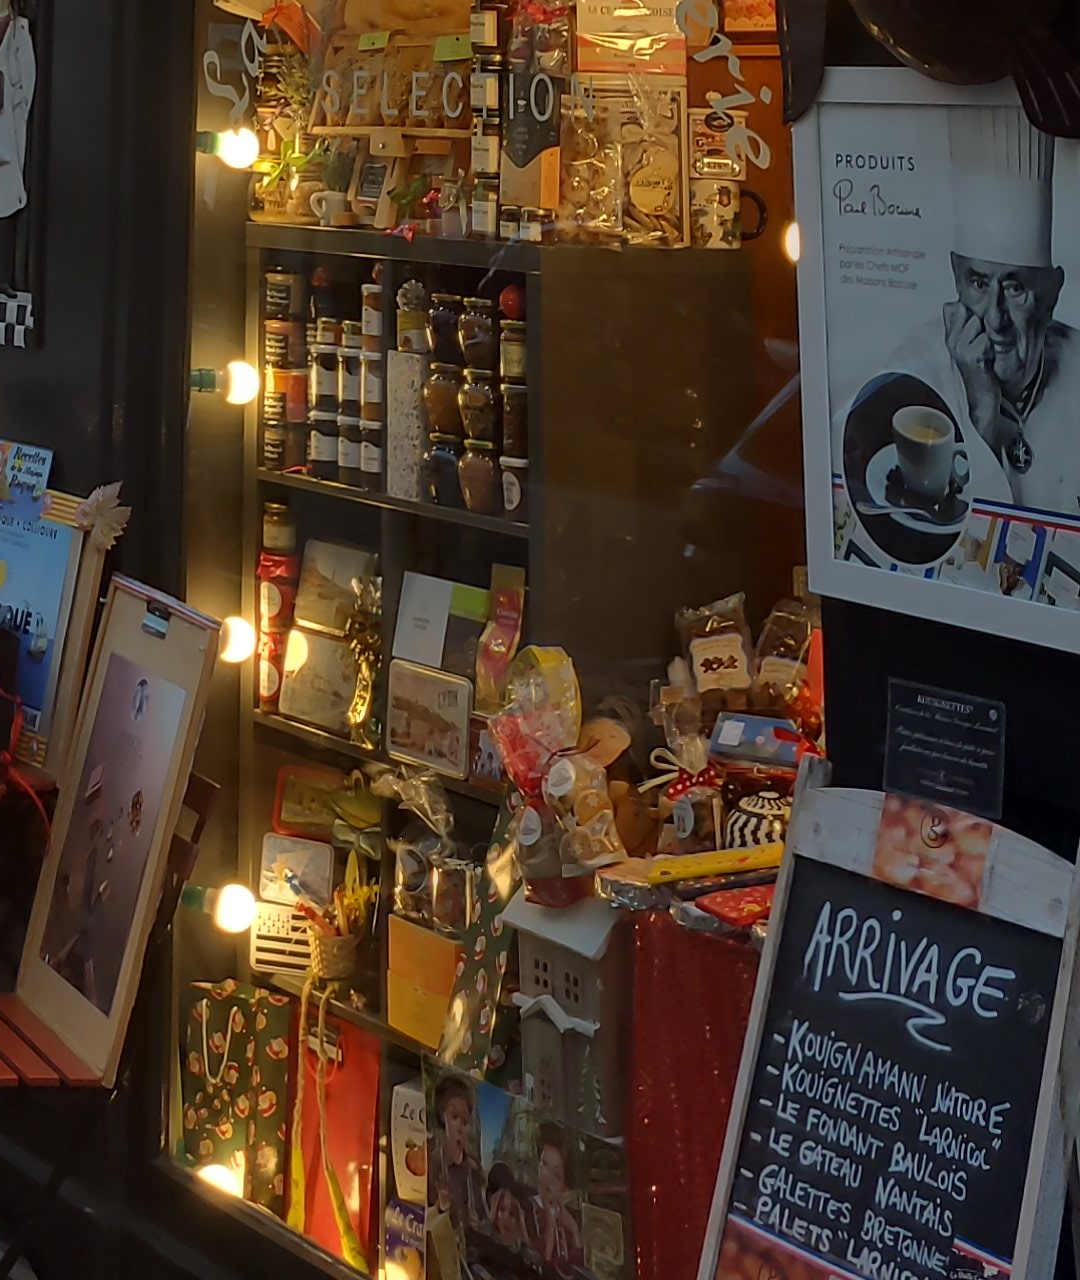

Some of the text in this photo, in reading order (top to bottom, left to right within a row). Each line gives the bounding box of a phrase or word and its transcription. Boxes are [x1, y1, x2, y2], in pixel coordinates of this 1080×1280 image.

[322, 70, 594, 123] SELECTION
[833, 178, 868, 216] Paul
[835, 153, 915, 171] PRODUITS
[802, 899, 1016, 1019] ARRIVAGE
[781, 1061, 901, 1131] KOUIGNETTES
[787, 1019, 1011, 1135] KOUIGN AMANN NATURE
[769, 1127, 794, 1157] LE
[875, 1176, 953, 1237] NANTAIS
[777, 1093, 968, 1202] LE FONDANT BAULOIS
[754, 1195, 832, 1253] PALETS
[758, 1164, 950, 1276] GALETTES BRETONNE
